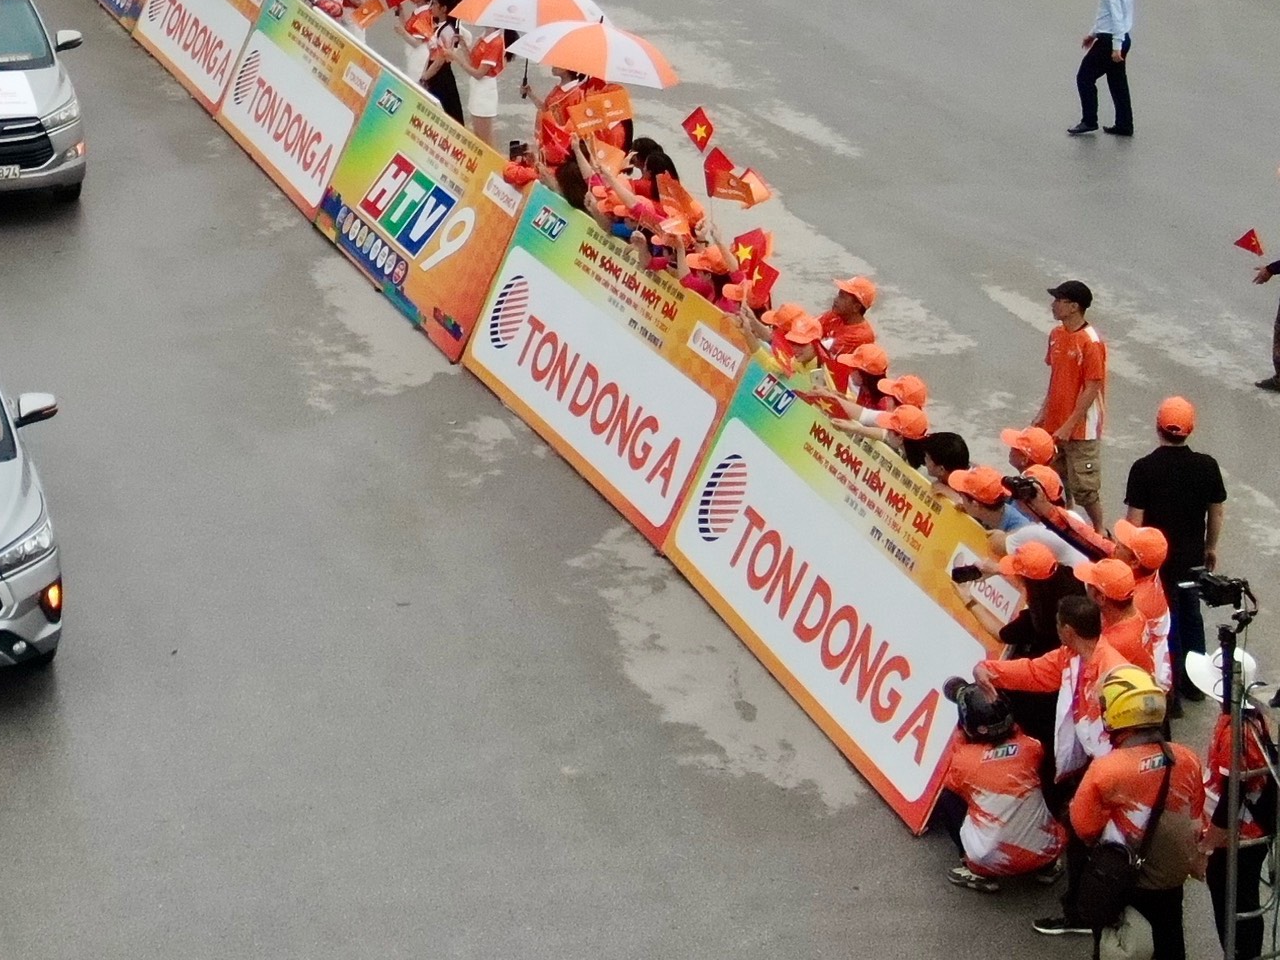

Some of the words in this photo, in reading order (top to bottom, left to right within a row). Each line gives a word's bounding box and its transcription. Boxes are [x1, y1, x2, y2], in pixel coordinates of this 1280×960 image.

[182, 19, 223, 76] DONG
[212, 49, 231, 86] A
[375, 88, 403, 118] HTV
[247, 77, 285, 128] TON
[273, 103, 323, 172] DONG
[311, 144, 334, 187] A
[532, 205, 567, 241] HTV
[578, 240, 600, 263] NON
[599, 255, 623, 283] SÔNG
[622, 271, 641, 295] LIỀN
[640, 285, 662, 311] MỘT
[699, 337, 713, 355] TON
[711, 347, 731, 367] DONG
[729, 360, 737, 373] A
[517, 315, 580, 401] TON
[568, 362, 660, 471] DONG
[645, 437, 682, 499] A
[753, 373, 796, 417] HTV
[809, 420, 835, 451] NON
[832, 443, 863, 480] SÔNG
[862, 467, 887, 498] LIỀN
[885, 487, 913, 522] MỘT
[977, 580, 1004, 608] DONG
[1002, 600, 1011, 616] A
[729, 505, 809, 621] TON
[792, 575, 912, 723] DONG
[893, 687, 941, 767] A
[981, 743, 1019, 764] HTV
[1140, 752, 1167, 772] HT
